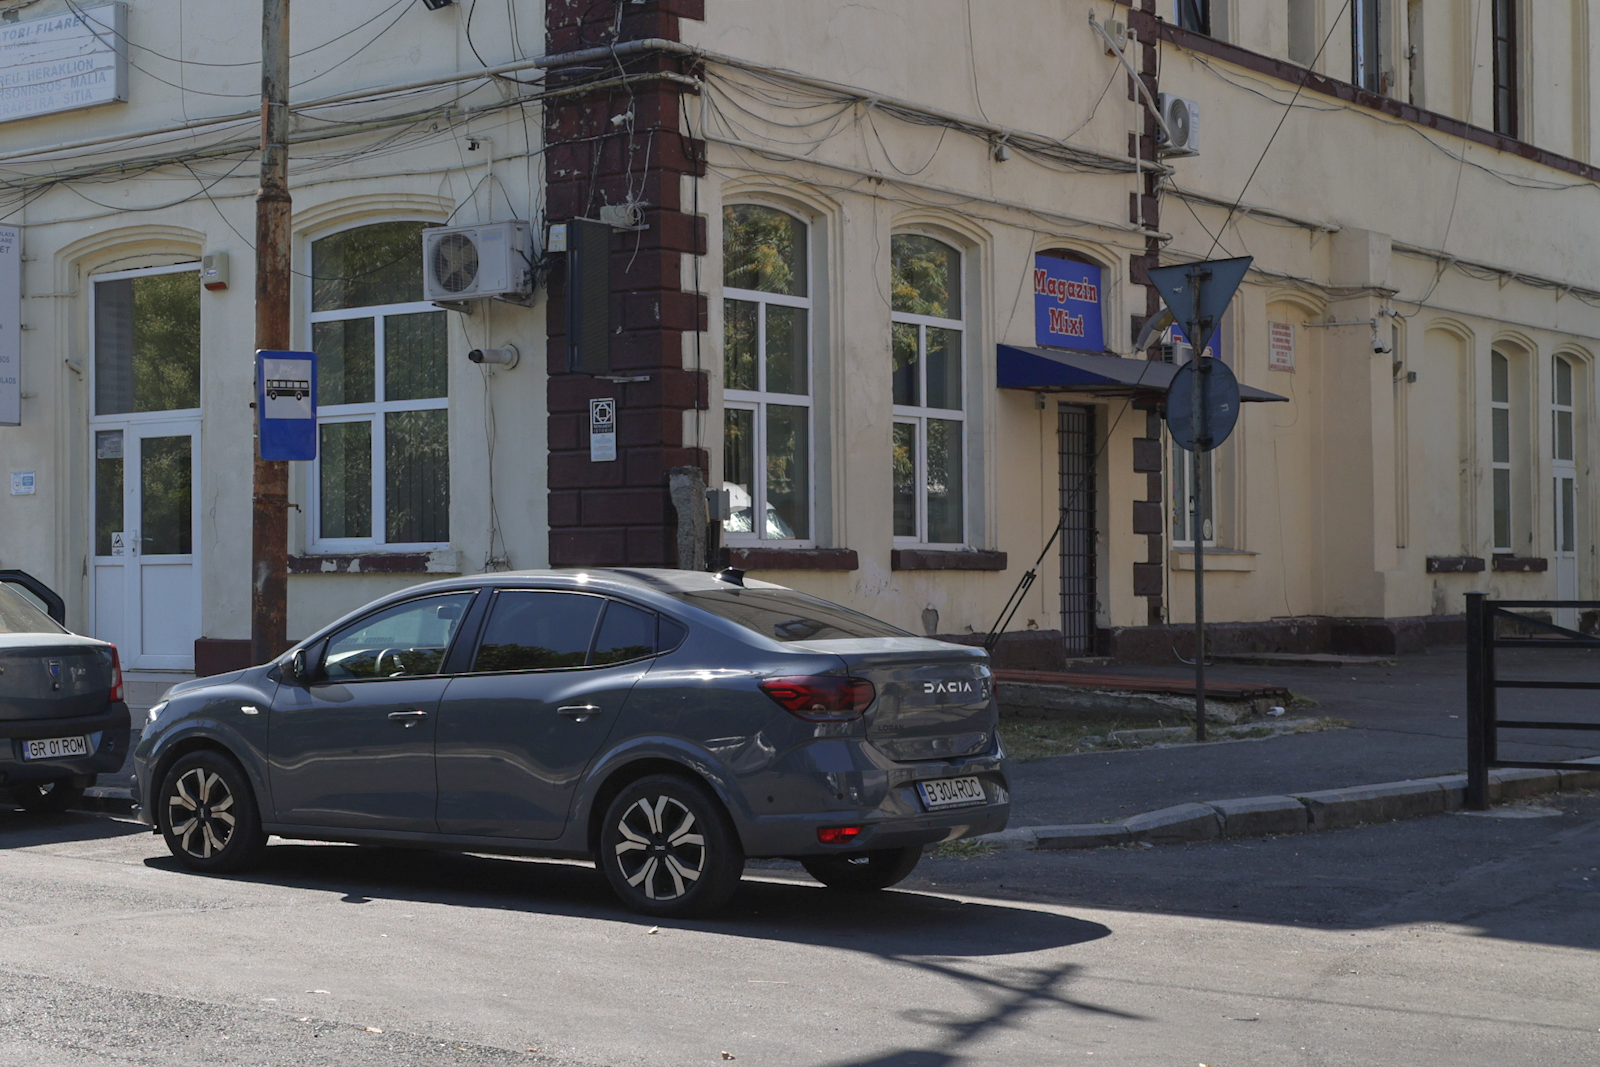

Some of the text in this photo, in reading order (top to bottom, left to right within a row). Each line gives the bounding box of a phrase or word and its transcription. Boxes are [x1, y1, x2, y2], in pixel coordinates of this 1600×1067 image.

[28, 58, 93, 81] HERAKLION
[70, 72, 106, 88] MALIA
[63, 89, 92, 104] SITIA
[1034, 268, 1098, 303] Magazin
[1049, 307, 1084, 337] Mixt
[923, 682, 972, 693] DACIA
[878, 724, 904, 732] LOGAN
[29, 737, 85, 757] GR 01 ROM
[925, 784, 938, 802] B
